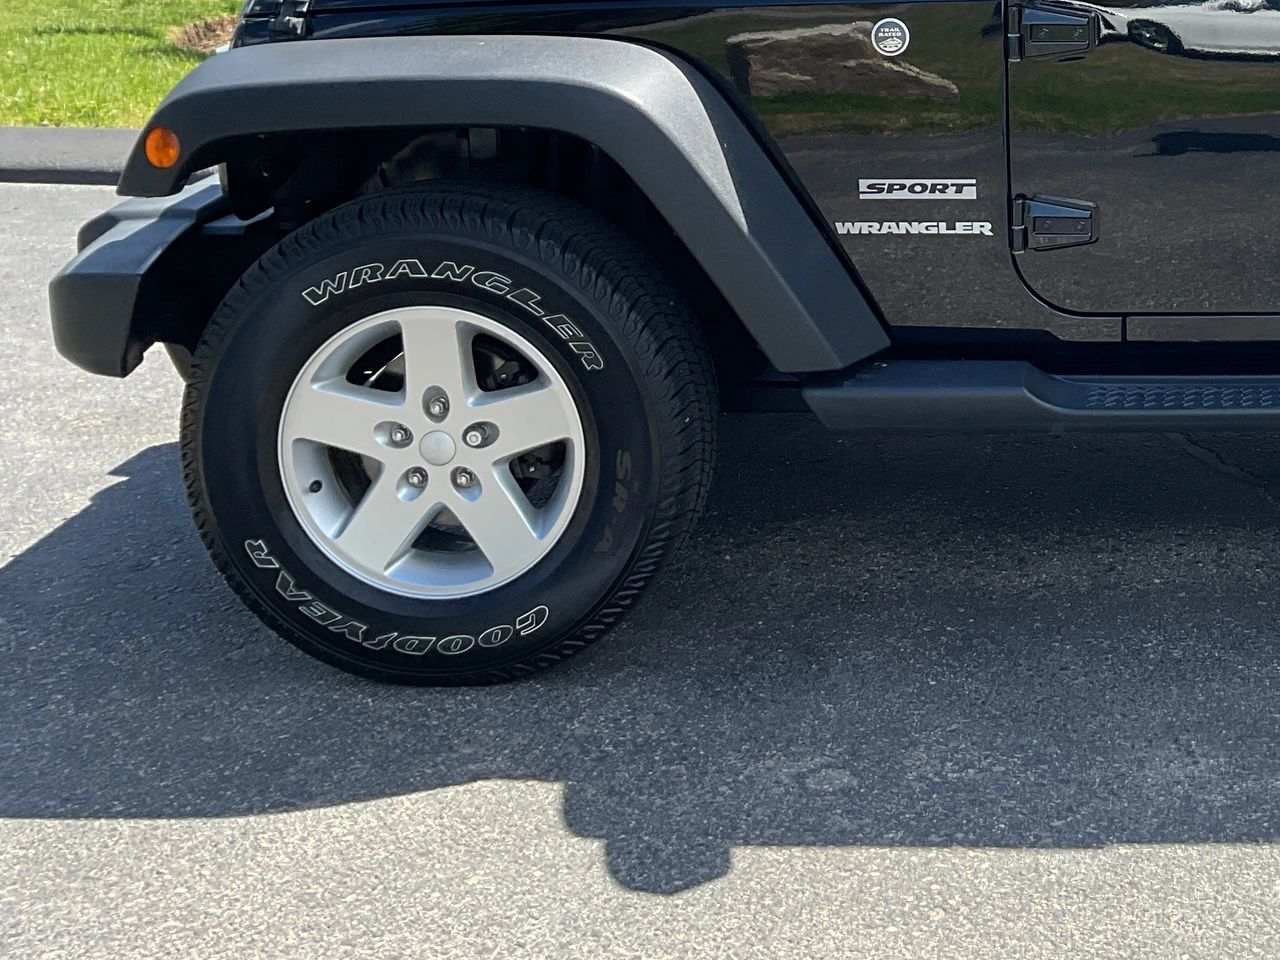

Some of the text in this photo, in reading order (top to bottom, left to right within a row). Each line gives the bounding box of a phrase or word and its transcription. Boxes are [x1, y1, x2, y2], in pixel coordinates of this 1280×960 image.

[861, 181, 976, 196] SPORT
[835, 221, 994, 236] WRANGLER
[302, 258, 604, 371] WRANGLER
[245, 539, 549, 655] GOODYEAR
